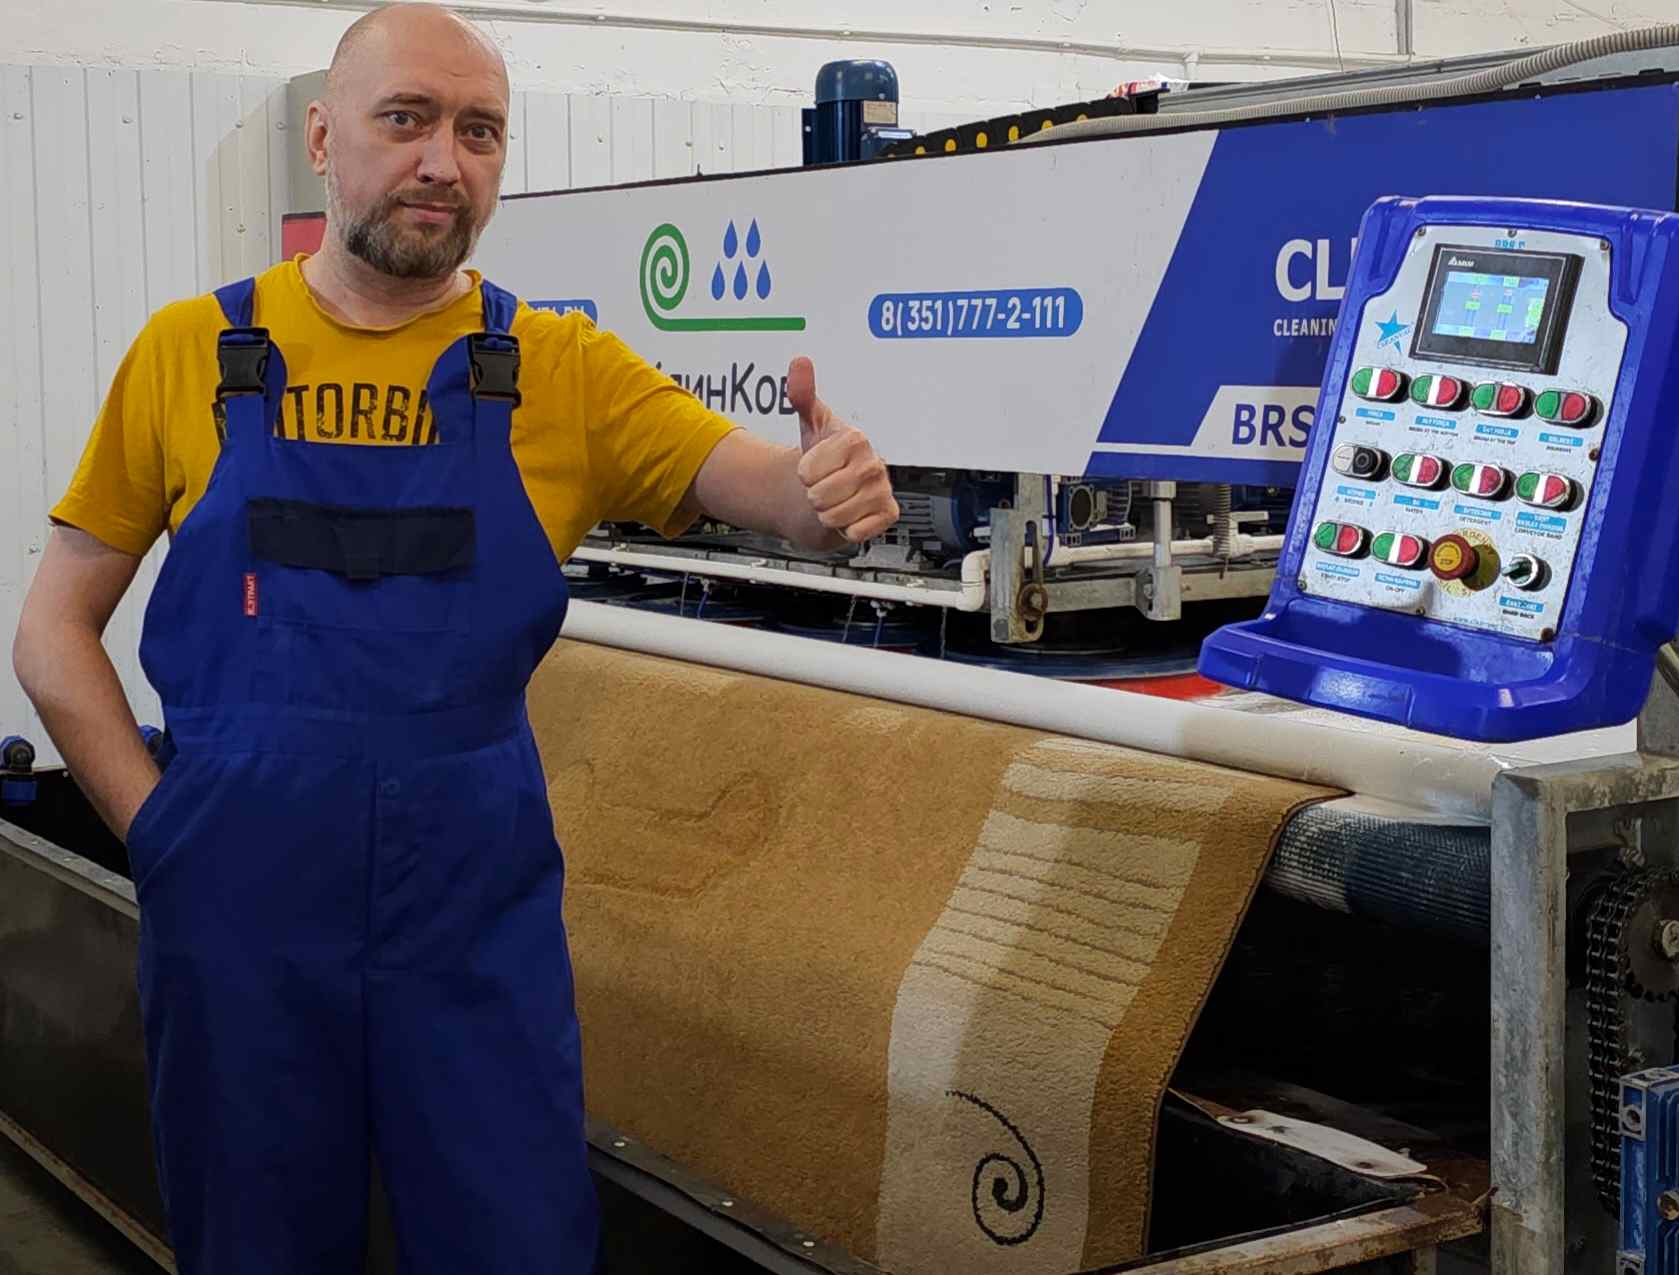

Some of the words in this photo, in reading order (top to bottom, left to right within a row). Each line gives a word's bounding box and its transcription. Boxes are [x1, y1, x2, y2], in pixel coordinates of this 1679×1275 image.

[1275, 236, 1358, 302] CL
[880, 295, 1066, 337] 8(351)777-2-111
[211, 382, 440, 448] TORBI
[655, 361, 797, 415] инКо
[1231, 403, 1316, 448] BRS
